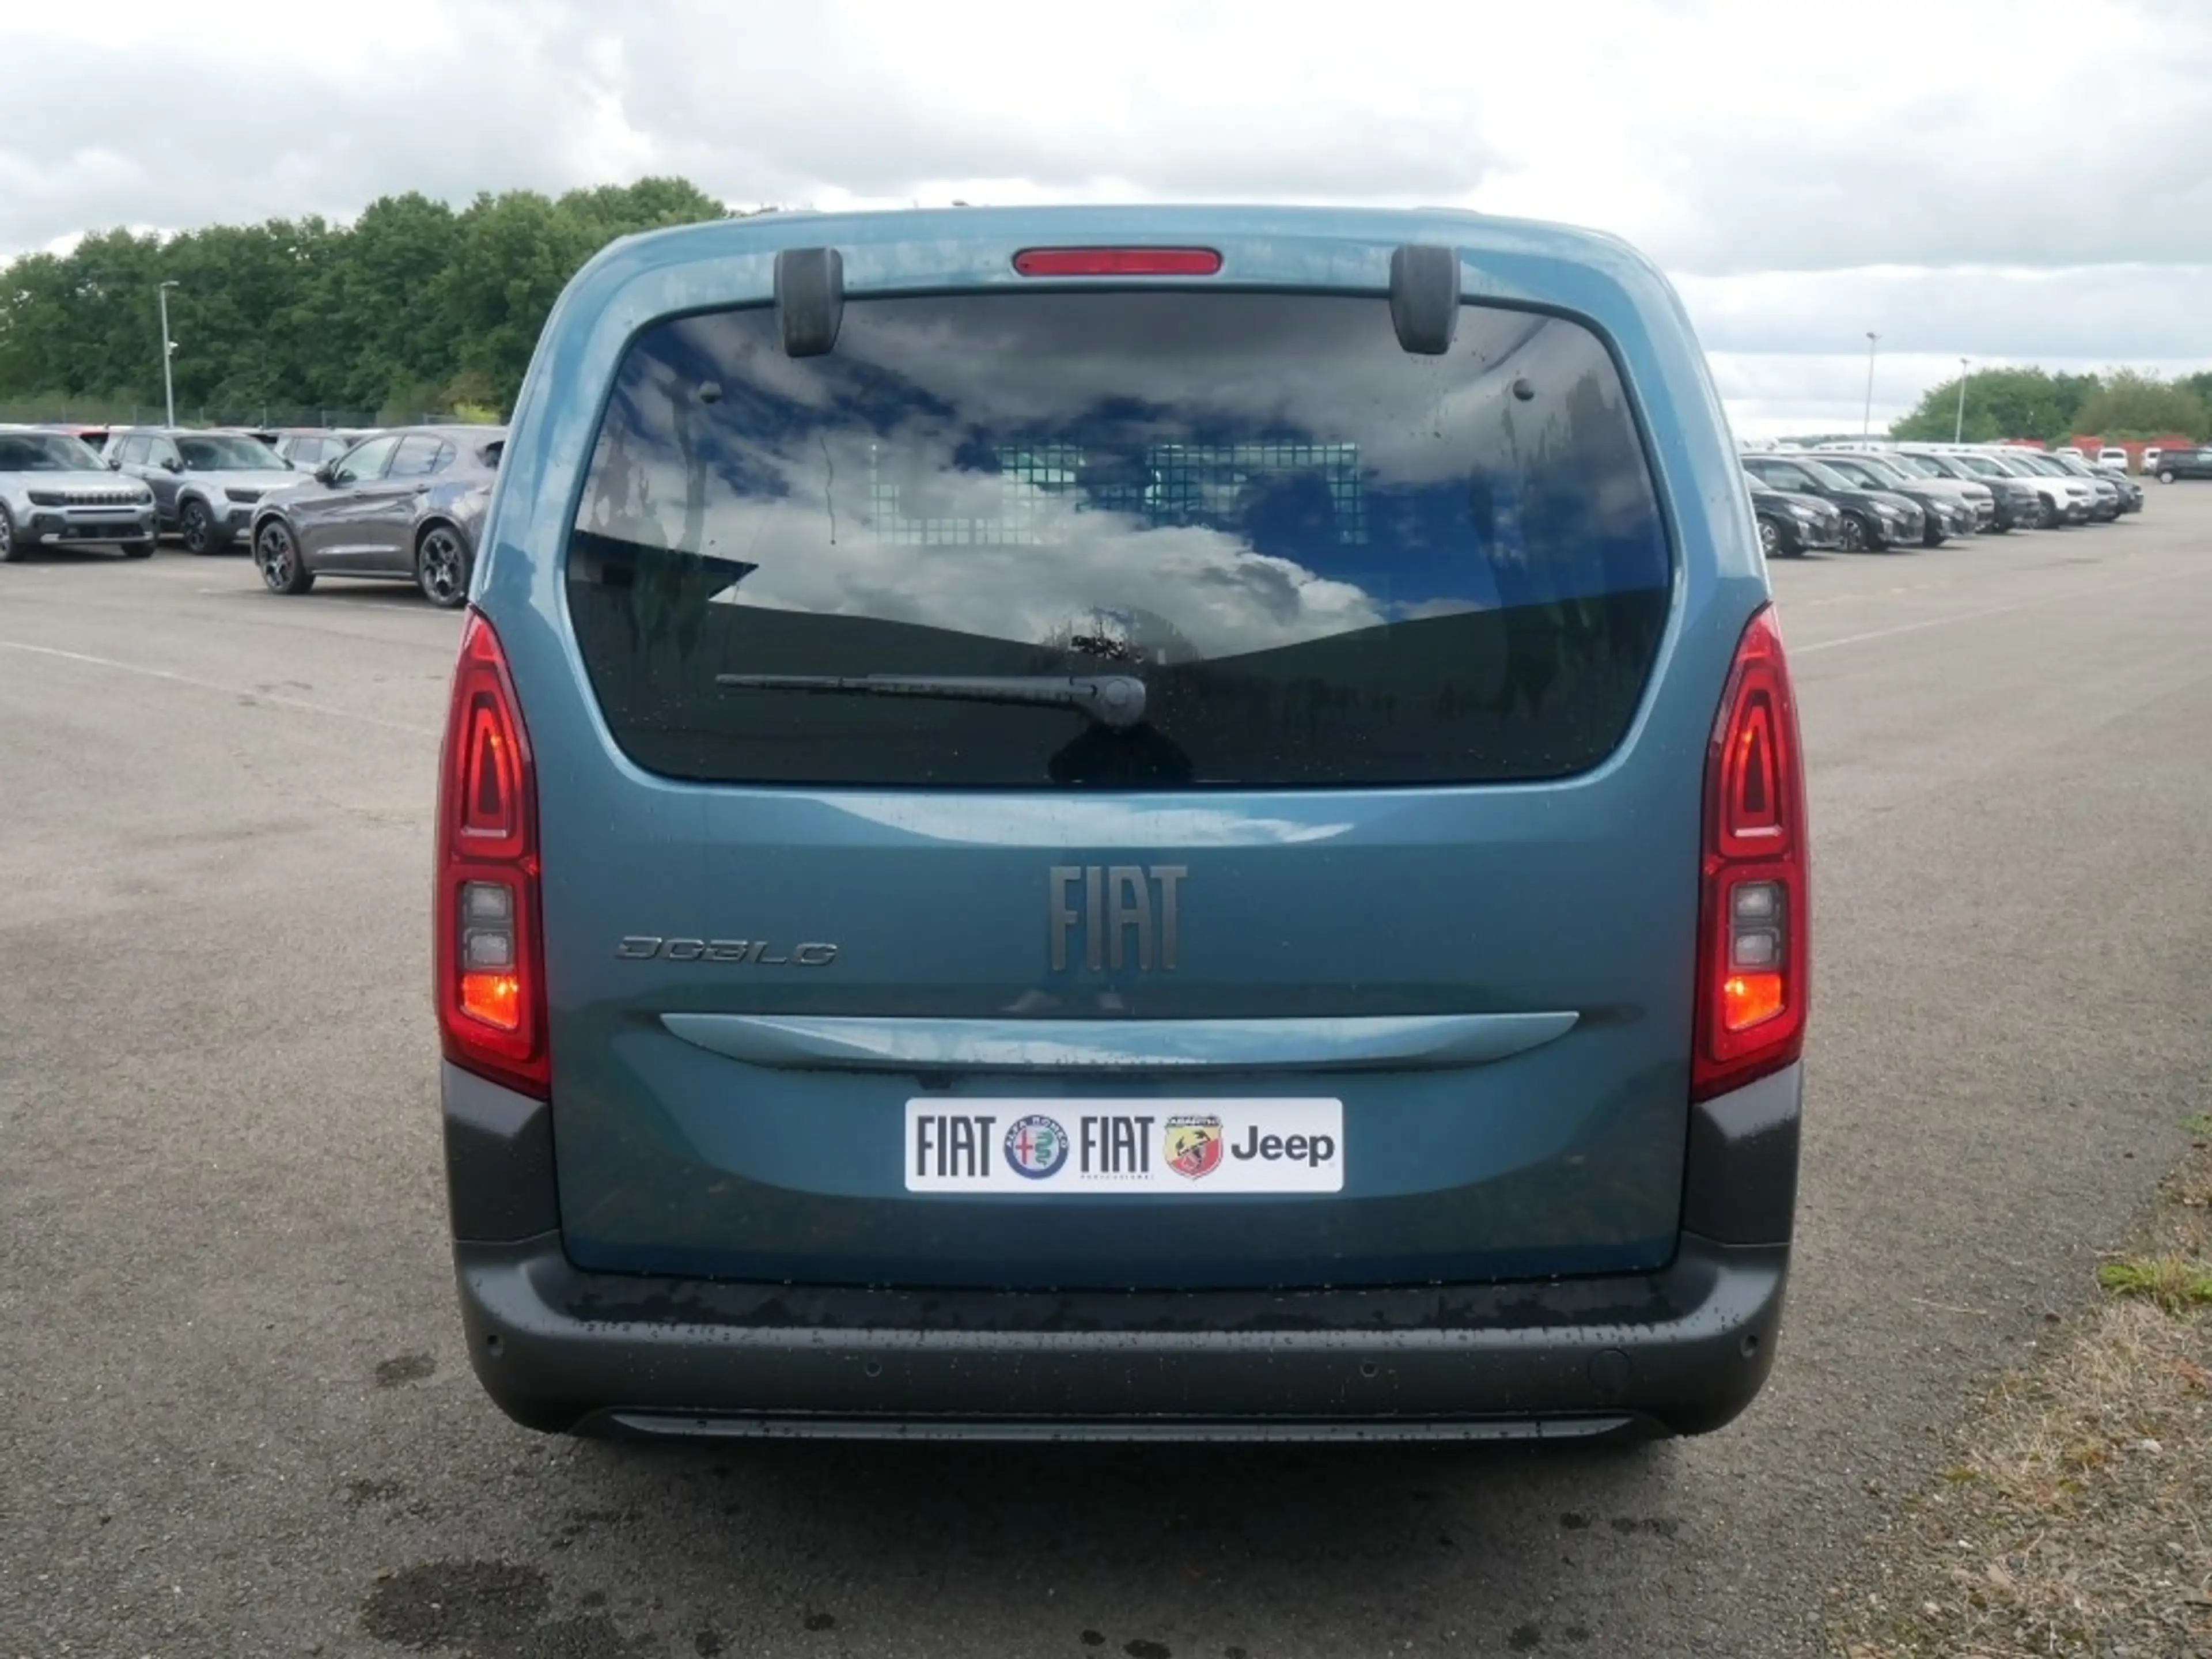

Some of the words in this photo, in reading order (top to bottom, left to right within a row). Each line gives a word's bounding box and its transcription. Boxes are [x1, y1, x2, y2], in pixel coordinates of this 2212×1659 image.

[1050, 866, 1188, 971] FIAT
[916, 1116, 997, 1177] FIAT
[1080, 1116, 1155, 1173] FIAT
[1231, 1125, 1335, 1167] Jeep
